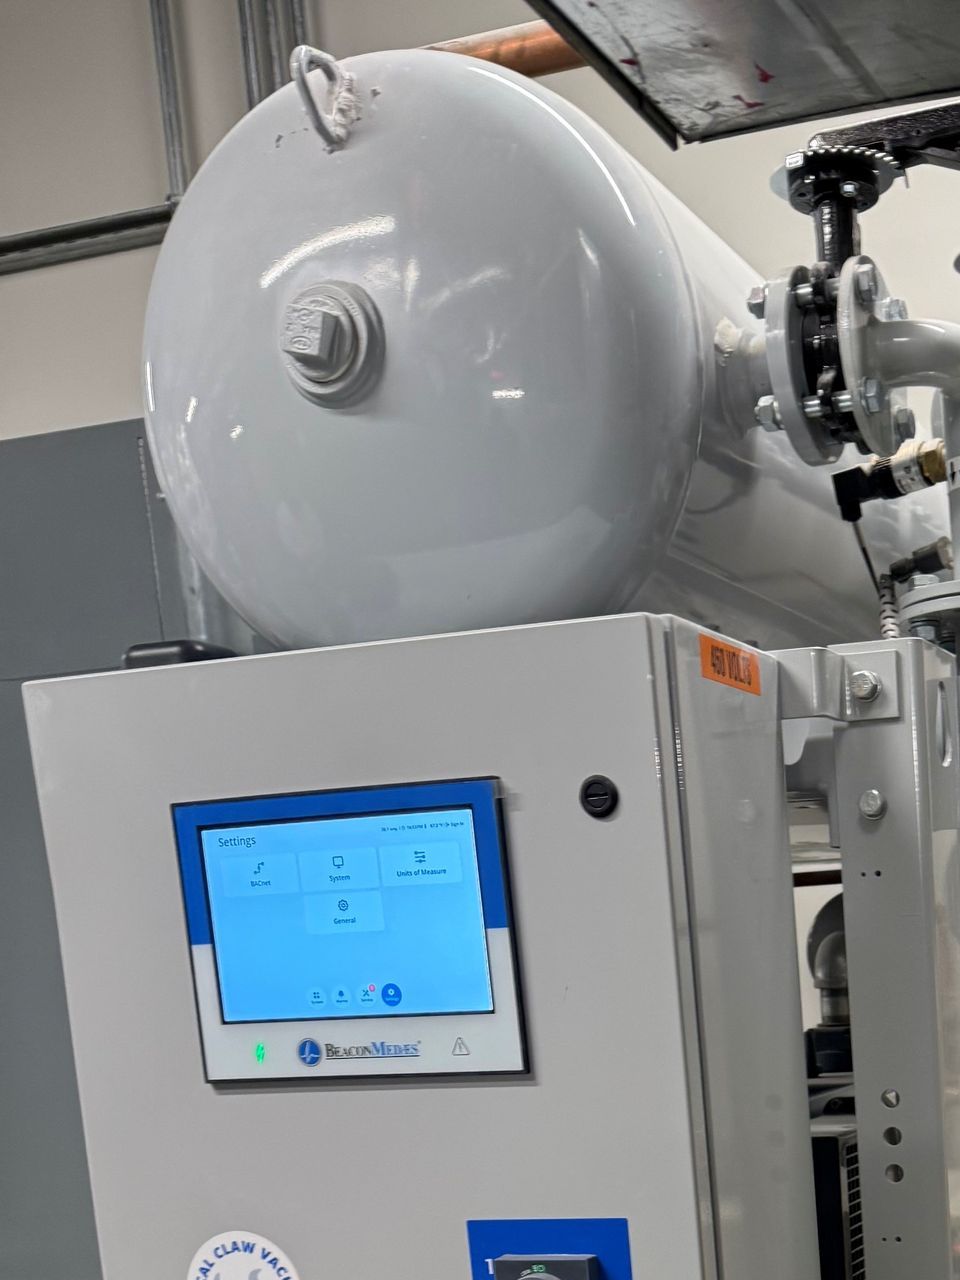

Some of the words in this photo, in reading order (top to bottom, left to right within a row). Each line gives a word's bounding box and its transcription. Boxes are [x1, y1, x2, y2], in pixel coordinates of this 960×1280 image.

[218, 835, 257, 848] Settings
[396, 870, 413, 878] Units
[413, 868, 420, 876] of
[421, 868, 447, 876] Measure
[329, 874, 351, 883] System
[333, 917, 357, 925] General
[213, 1240, 256, 1259] CLAW
